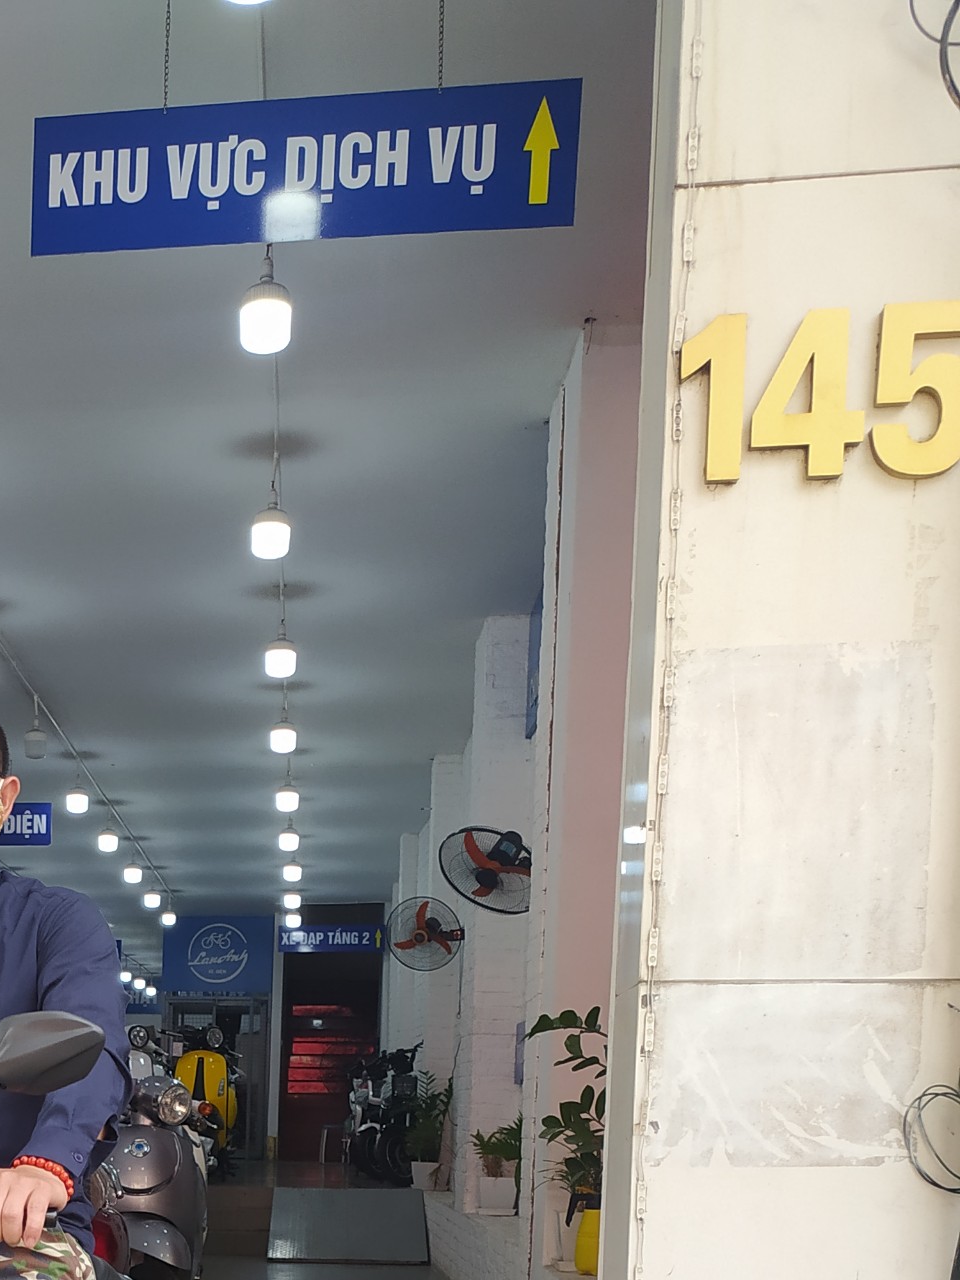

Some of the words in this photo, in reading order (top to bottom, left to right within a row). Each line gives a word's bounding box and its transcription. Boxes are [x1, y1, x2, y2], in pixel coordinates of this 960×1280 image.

[48, 146, 150, 208] KHU
[166, 134, 267, 210] VỰC
[283, 129, 410, 204] DỊCH
[428, 123, 498, 195] VỤ
[680, 300, 960, 484] 145
[3, 809, 47, 839] ĐIỆN
[361, 931, 370, 945] 2
